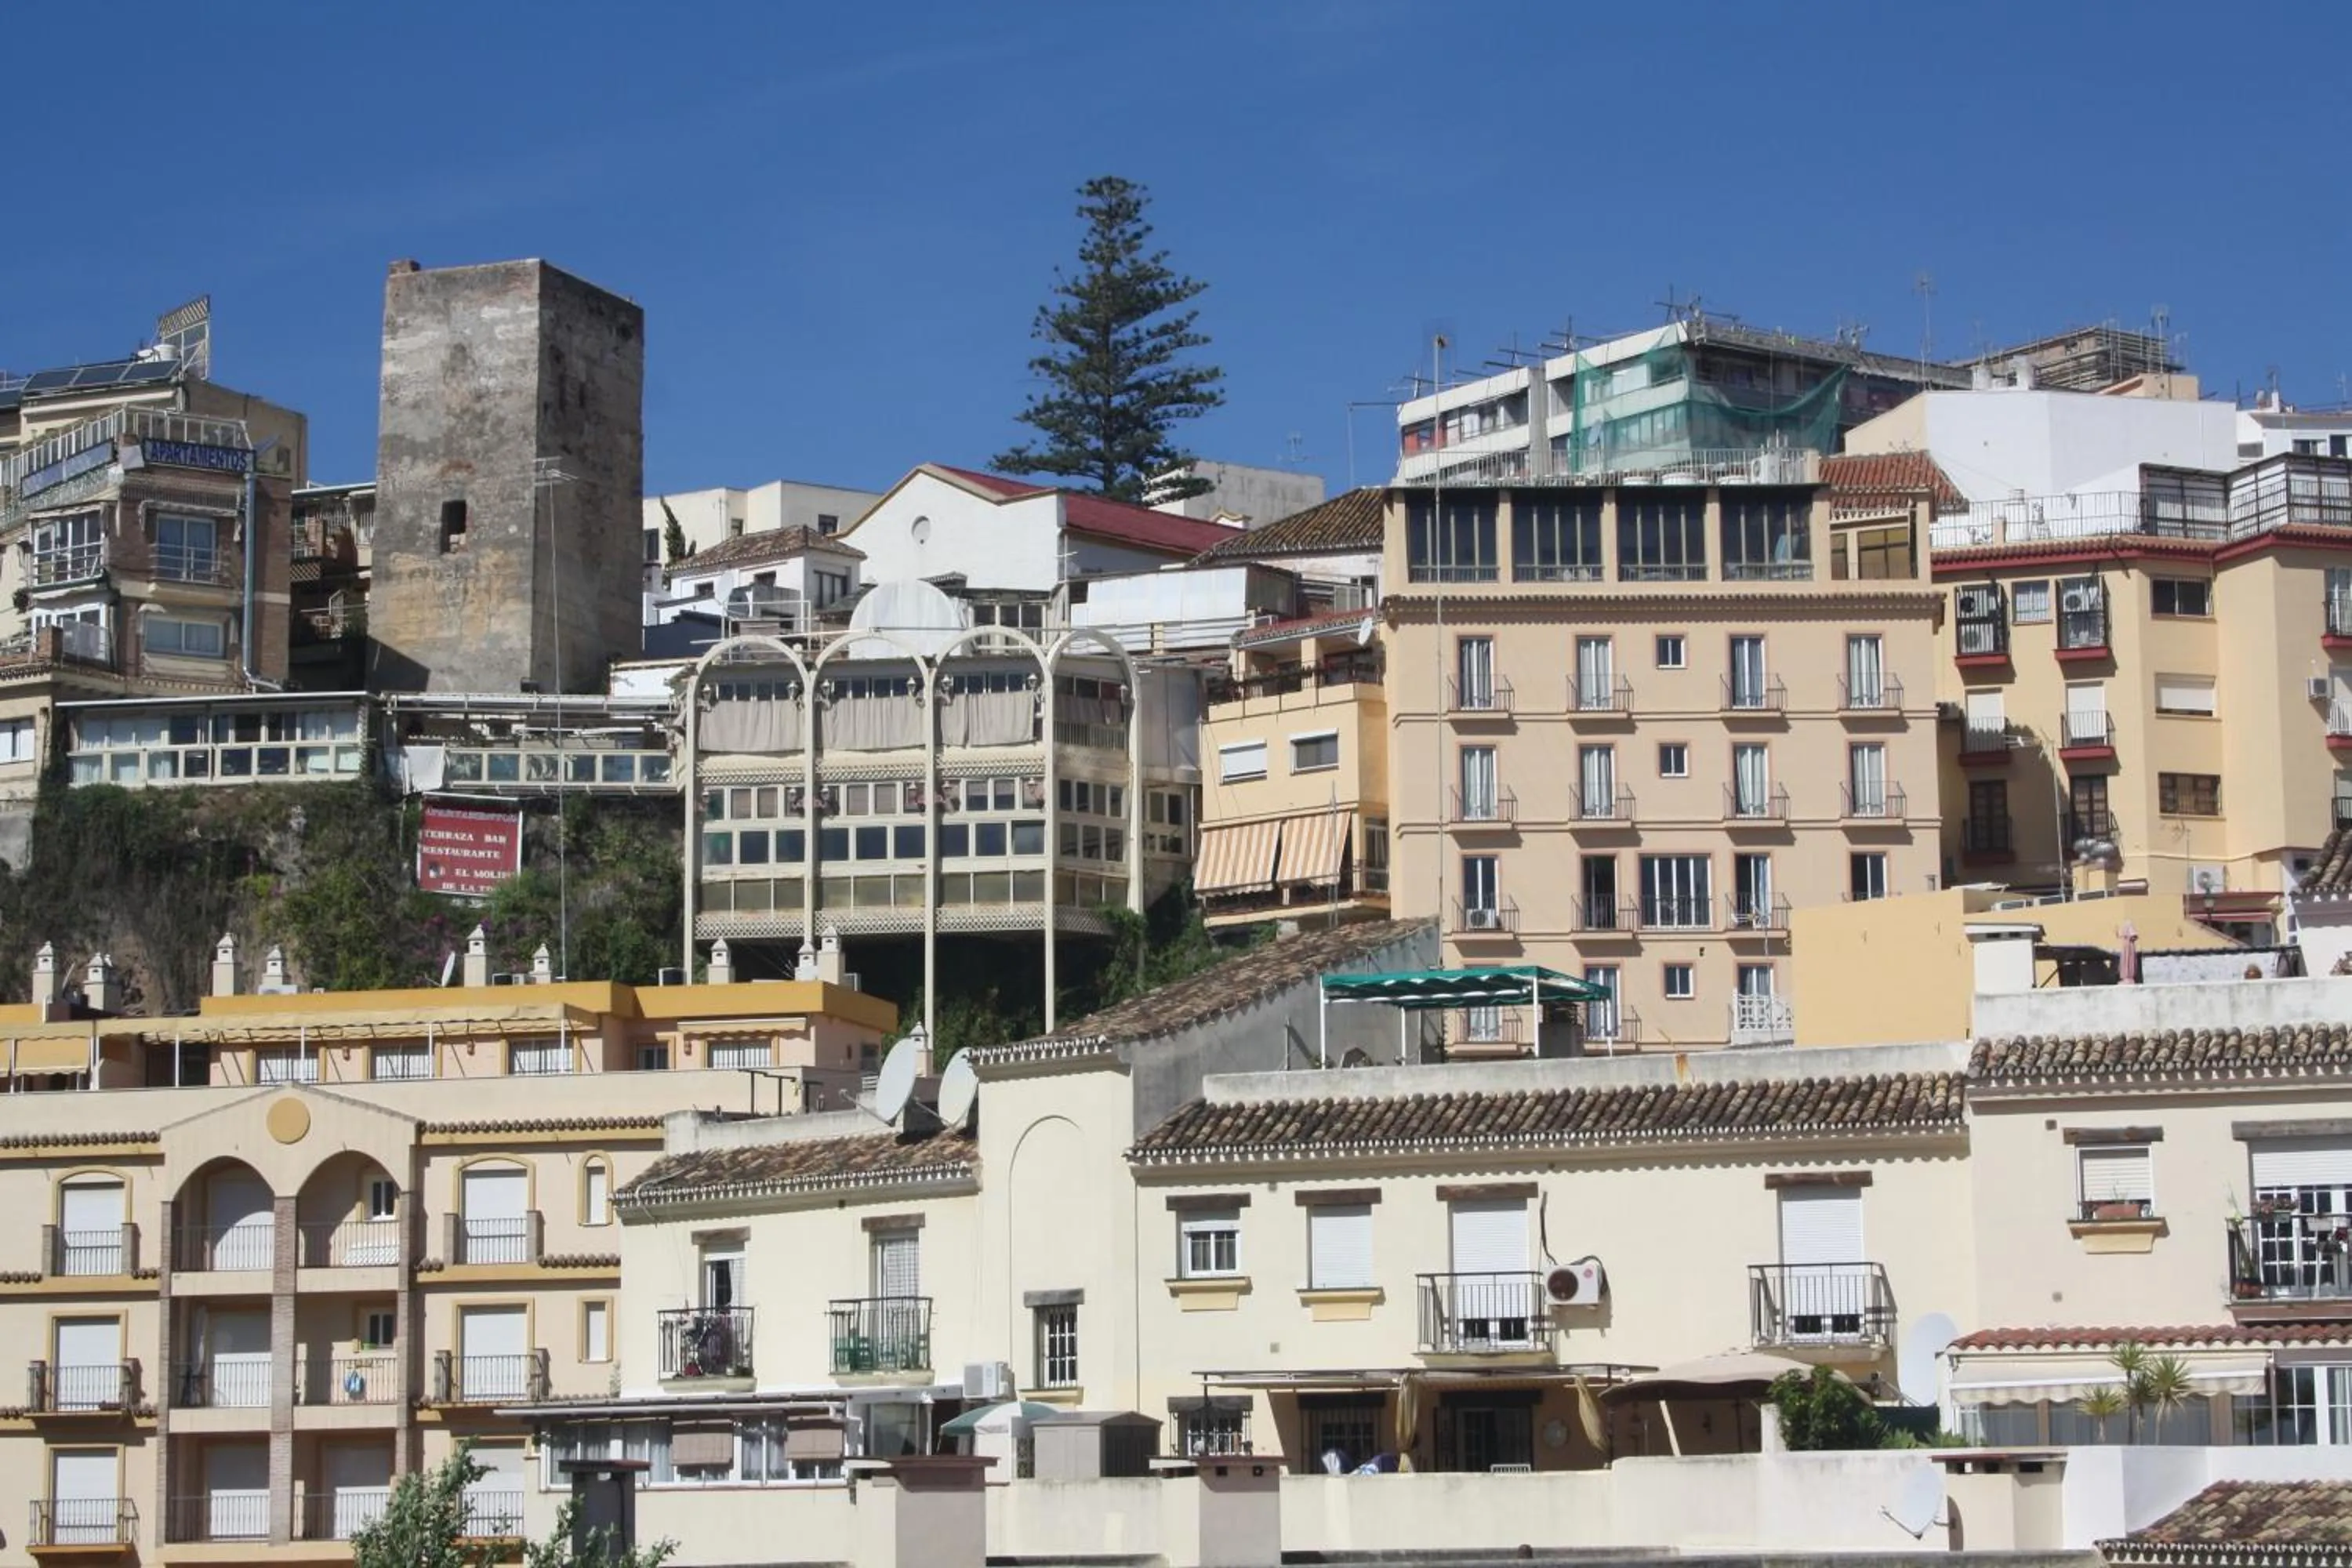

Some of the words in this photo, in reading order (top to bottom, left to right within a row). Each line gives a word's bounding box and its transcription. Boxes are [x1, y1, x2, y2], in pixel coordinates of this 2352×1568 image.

[151, 443, 247, 473] APARTAMENTOS
[426, 830, 474, 841] TERRAZA
[484, 834, 506, 844] BAR
[423, 846, 500, 859] RESTAURANTE
[455, 868, 470, 877] EL
[442, 882, 456, 891] DE
[460, 884, 475, 892] LA
